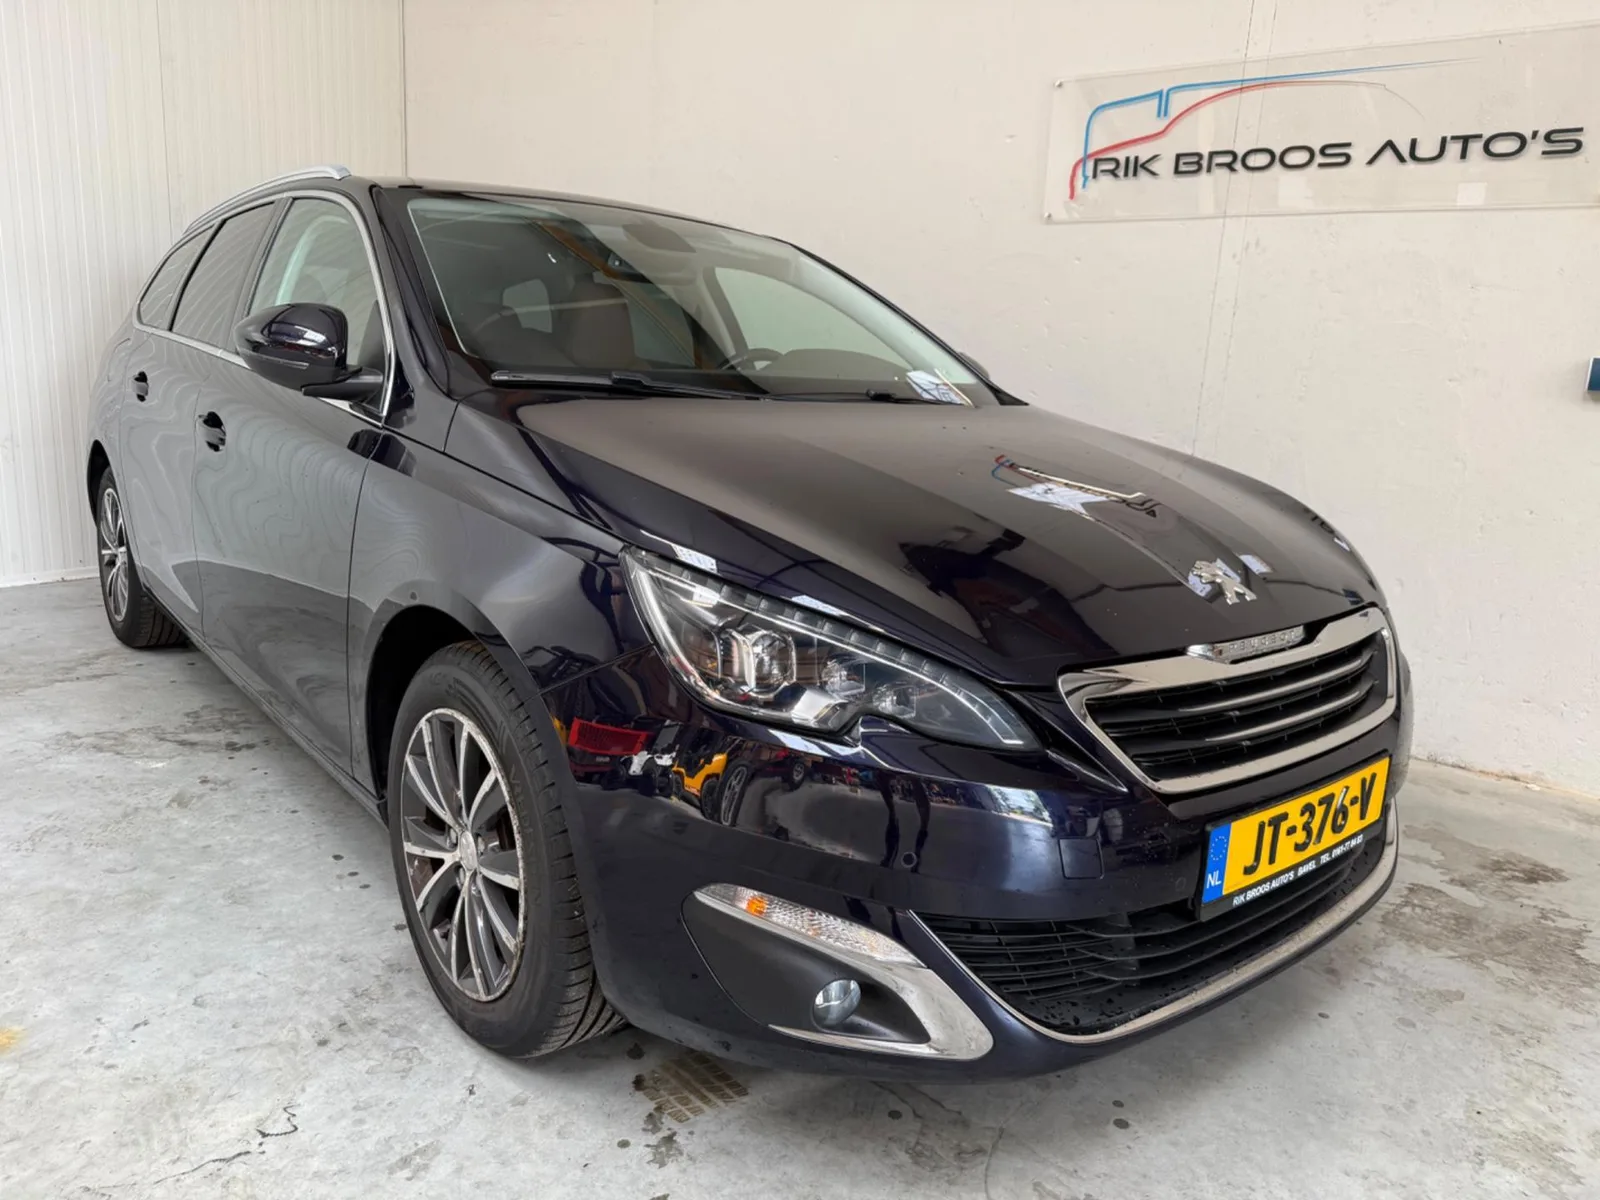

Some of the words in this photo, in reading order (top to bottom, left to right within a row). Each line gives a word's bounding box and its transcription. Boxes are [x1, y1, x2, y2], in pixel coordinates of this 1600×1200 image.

[1091, 152, 1163, 180] RIK
[1173, 141, 1352, 176] BROOS
[1365, 126, 1585, 166] AUTO'S
[1242, 771, 1377, 876] JT-376-V
[1206, 870, 1222, 889] NL
[1232, 892, 1246, 908] RIK
[1246, 881, 1271, 901] BROOS
[1270, 870, 1295, 890] AUTO'S
